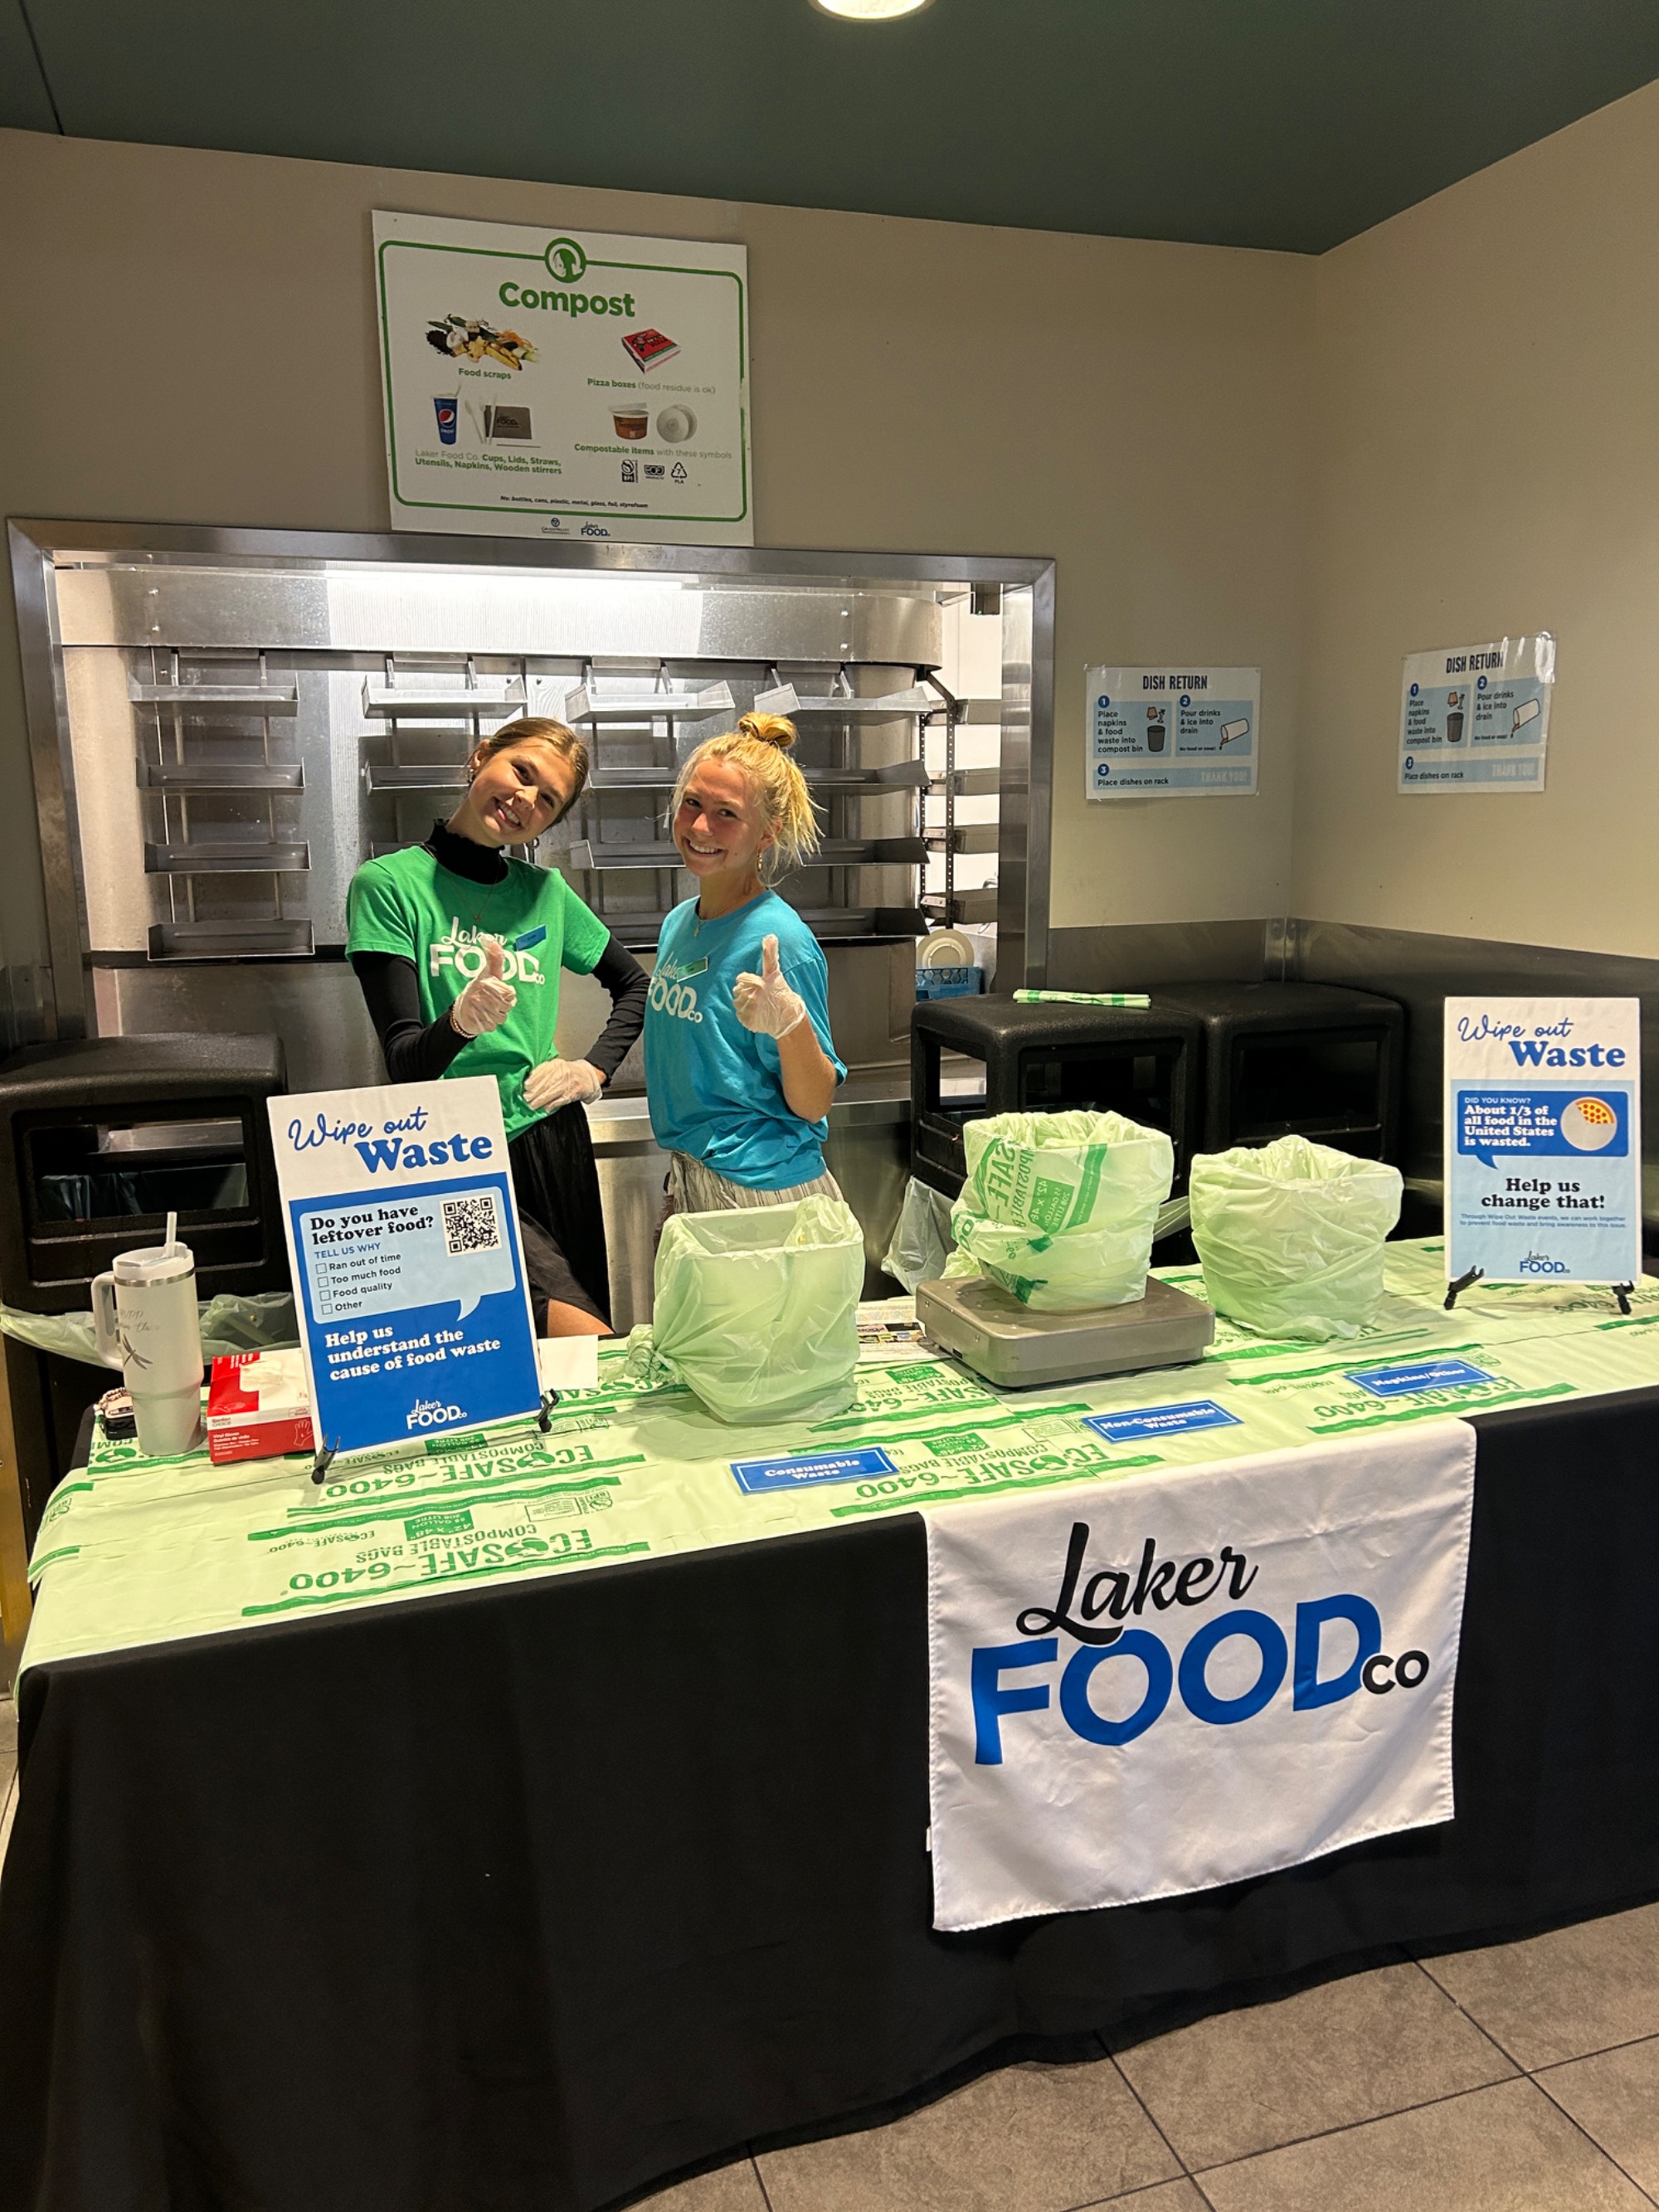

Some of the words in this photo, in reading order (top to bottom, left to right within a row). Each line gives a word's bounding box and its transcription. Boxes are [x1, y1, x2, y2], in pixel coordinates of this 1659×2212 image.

[499, 281, 635, 317] Compost
[459, 368, 481, 377] Food
[484, 369, 511, 379] scraps
[587, 378, 610, 387] Pizza
[612, 380, 635, 388] boxes
[639, 382, 660, 391] (food
[663, 383, 691, 392] residue
[442, 451, 464, 460] Food
[482, 455, 506, 463] Cups,
[508, 456, 528, 465] Lids,
[531, 457, 561, 466] Straws,
[575, 444, 629, 454] Compostable
[631, 446, 654, 455] items
[699, 451, 732, 459] symbols
[416, 458, 452, 467] Utensils,
[455, 461, 492, 470] Napkins,
[1446, 657, 1467, 674] DISH
[1469, 652, 1503, 670] RETURN
[1143, 676, 1165, 689] DISH
[1170, 675, 1208, 689] RETURN
[1458, 1015, 1525, 1041] Wipe
[1535, 1017, 1574, 1037] out
[1509, 1040, 1625, 1067] Waste
[1464, 1106, 1507, 1115] About
[1510, 1106, 1531, 1116] 1/3
[1535, 1106, 1550, 1115] of
[289, 1113, 372, 1151] Wipe
[384, 1106, 428, 1134] out
[1464, 1116, 1481, 1125] all
[1484, 1116, 1515, 1126] food
[1518, 1117, 1531, 1125] in
[1535, 1116, 1557, 1125] the
[1464, 1127, 1510, 1137] United
[1513, 1127, 1554, 1137] States
[1464, 1137, 1477, 1147] is
[1480, 1137, 1530, 1147] wasted.
[354, 1133, 492, 1173] Waste
[1506, 1178, 1551, 1194] Help
[1557, 1181, 1580, 1192] us
[1481, 1195, 1550, 1211] change
[1556, 1196, 1604, 1209] that!
[310, 1217, 335, 1230] Do
[340, 1213, 373, 1228] you
[377, 1206, 418, 1220] have
[312, 1225, 383, 1245] leftover
[388, 1216, 434, 1234] food?
[314, 1250, 339, 1259] TELL
[342, 1247, 354, 1255] US
[358, 1242, 381, 1252] WHY
[1525, 1251, 1550, 1261] Laker
[329, 1263, 347, 1271] Ran
[350, 1259, 365, 1267] out
[368, 1256, 378, 1264] of
[381, 1253, 401, 1263] time
[1520, 1261, 1565, 1274] FOOD
[332, 1276, 348, 1284] Too
[352, 1270, 377, 1280] much
[379, 1266, 401, 1276] food
[333, 1289, 358, 1298] Food
[361, 1283, 392, 1294] quality
[335, 1301, 362, 1311] Other
[325, 1330, 367, 1347] Help
[372, 1326, 393, 1339] us
[328, 1333, 431, 1364] understand
[435, 1330, 464, 1344] the
[329, 1362, 380, 1381] cause
[384, 1357, 402, 1371] of
[406, 1348, 446, 1367] food
[450, 1338, 501, 1357] waste
[1370, 1367, 1467, 1387] Napkins/Other
[411, 1399, 442, 1415] Laker
[406, 1405, 461, 1430] FOOD
[1100, 1406, 1217, 1431] Non-Consumable
[1144, 1418, 1188, 1433] Waste
[431, 1441, 544, 1464] COMPOSTABLE
[941, 1443, 1048, 1467] COMPOSTABLE
[382, 1457, 426, 1474] BAGS
[765, 1459, 860, 1477] Consumable
[792, 1469, 840, 1480] Waste
[410, 1518, 447, 1530] GALLON
[410, 1523, 538, 1553] COMPOSTABLE
[355, 1546, 403, 1563] BAGS
[1015, 1522, 1258, 1645] Laker
[971, 1594, 1381, 1765] FOOD
